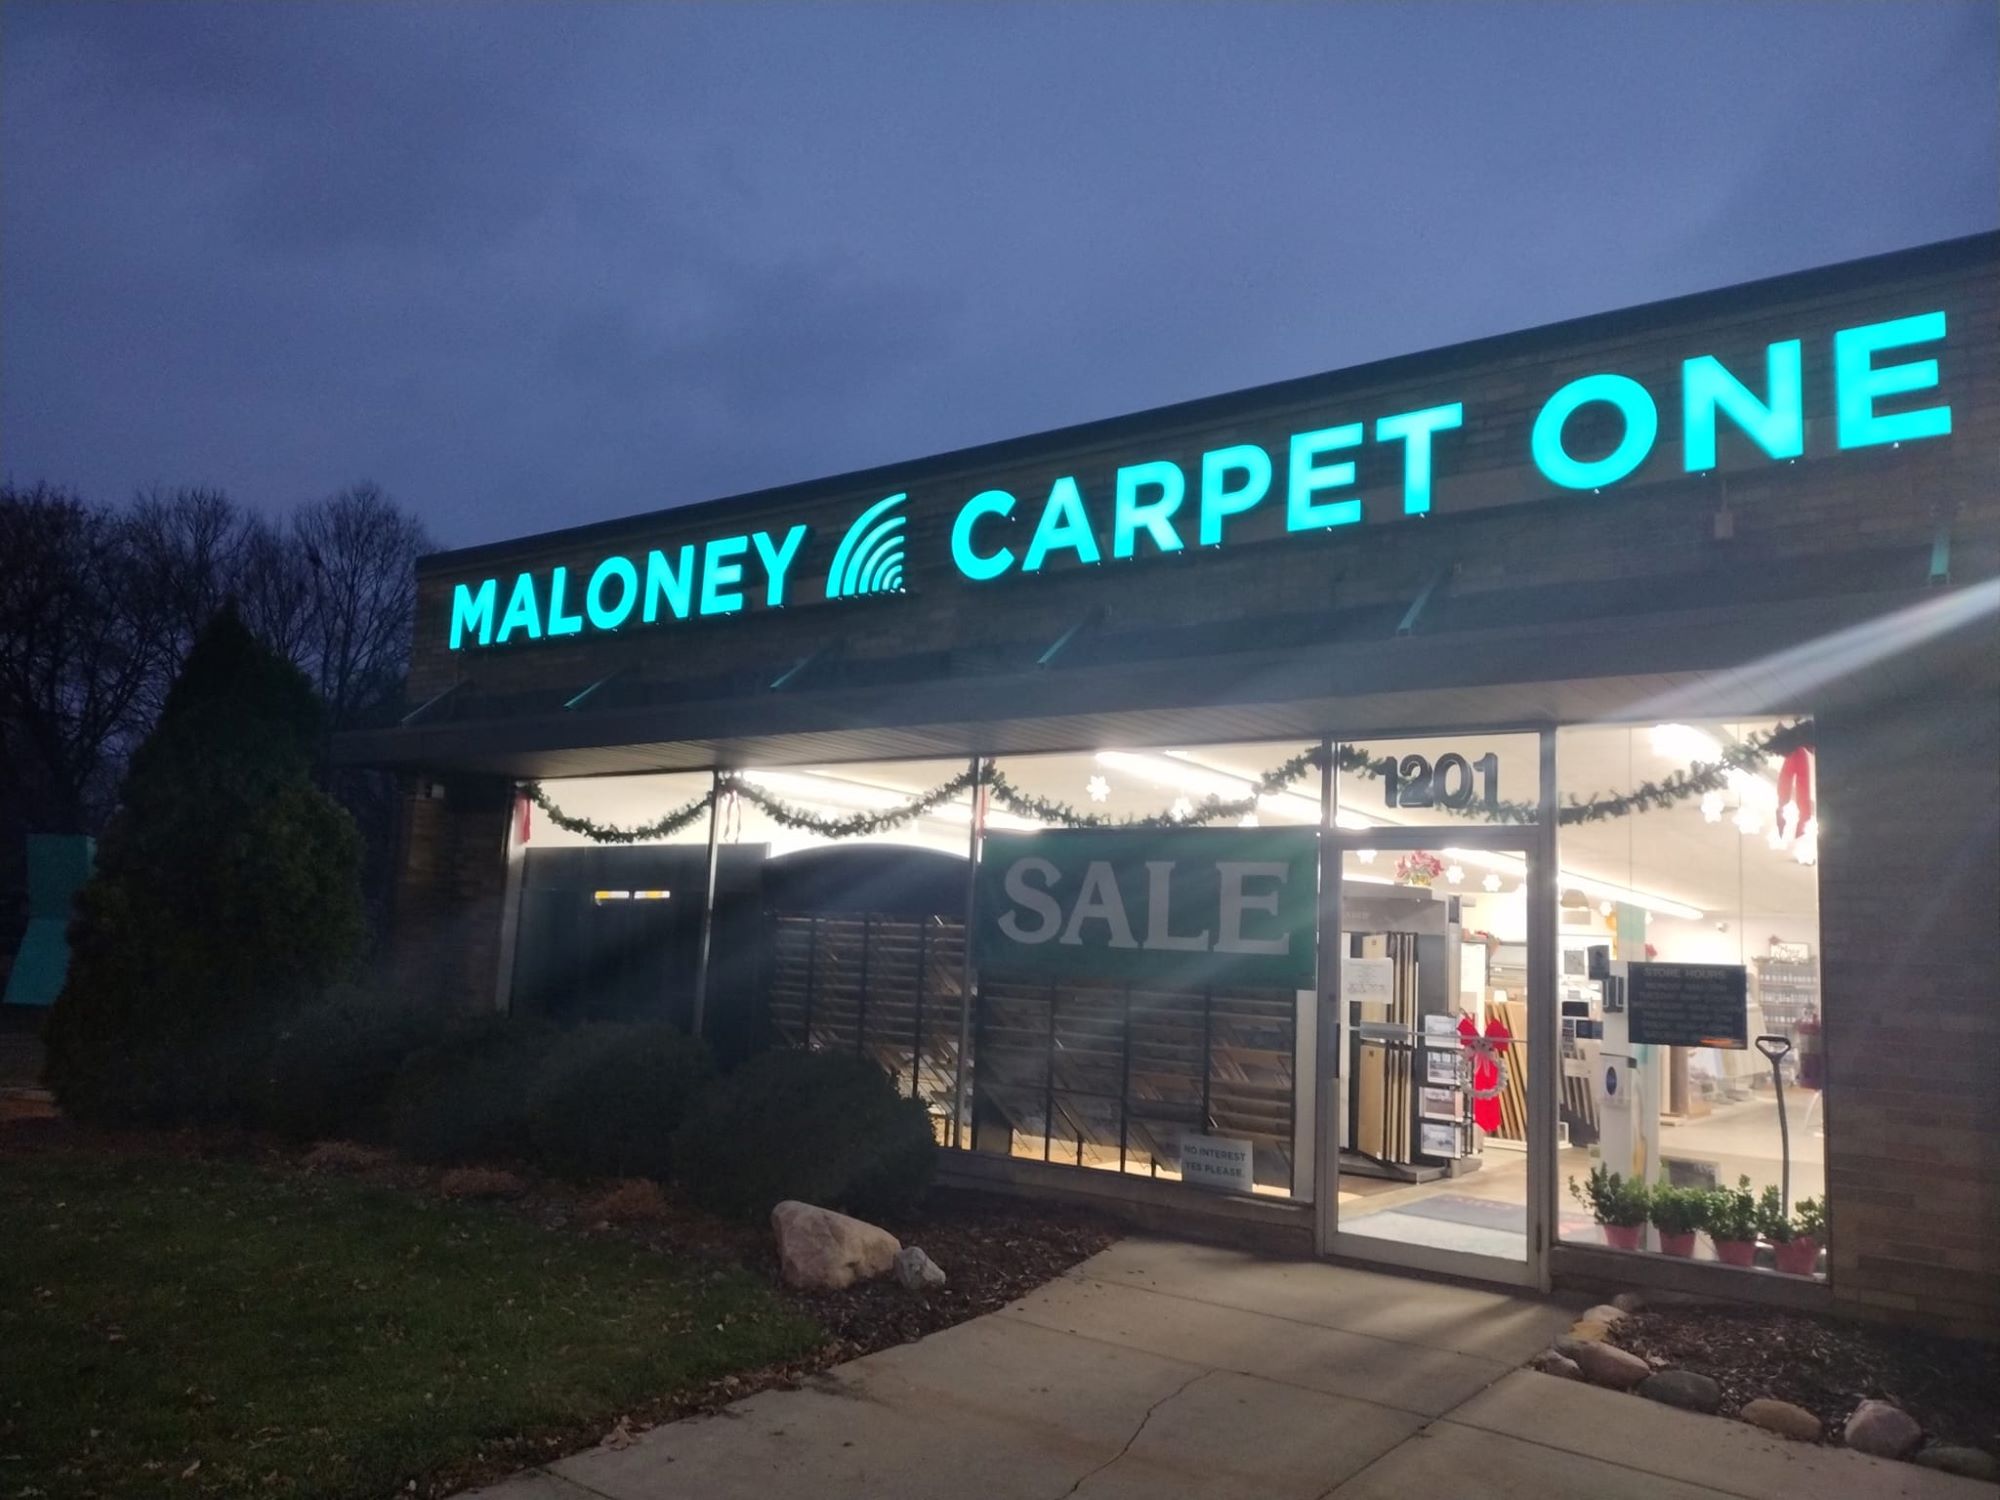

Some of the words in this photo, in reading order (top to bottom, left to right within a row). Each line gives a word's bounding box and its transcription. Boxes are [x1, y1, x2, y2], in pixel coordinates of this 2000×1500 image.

[449, 524, 807, 650] MALONEY
[951, 401, 1463, 581] CARPET
[1530, 310, 1953, 490] ONE
[1375, 752, 1498, 809] 1201
[997, 856, 1291, 955] SALE
[1184, 1145, 1198, 1155] NO
